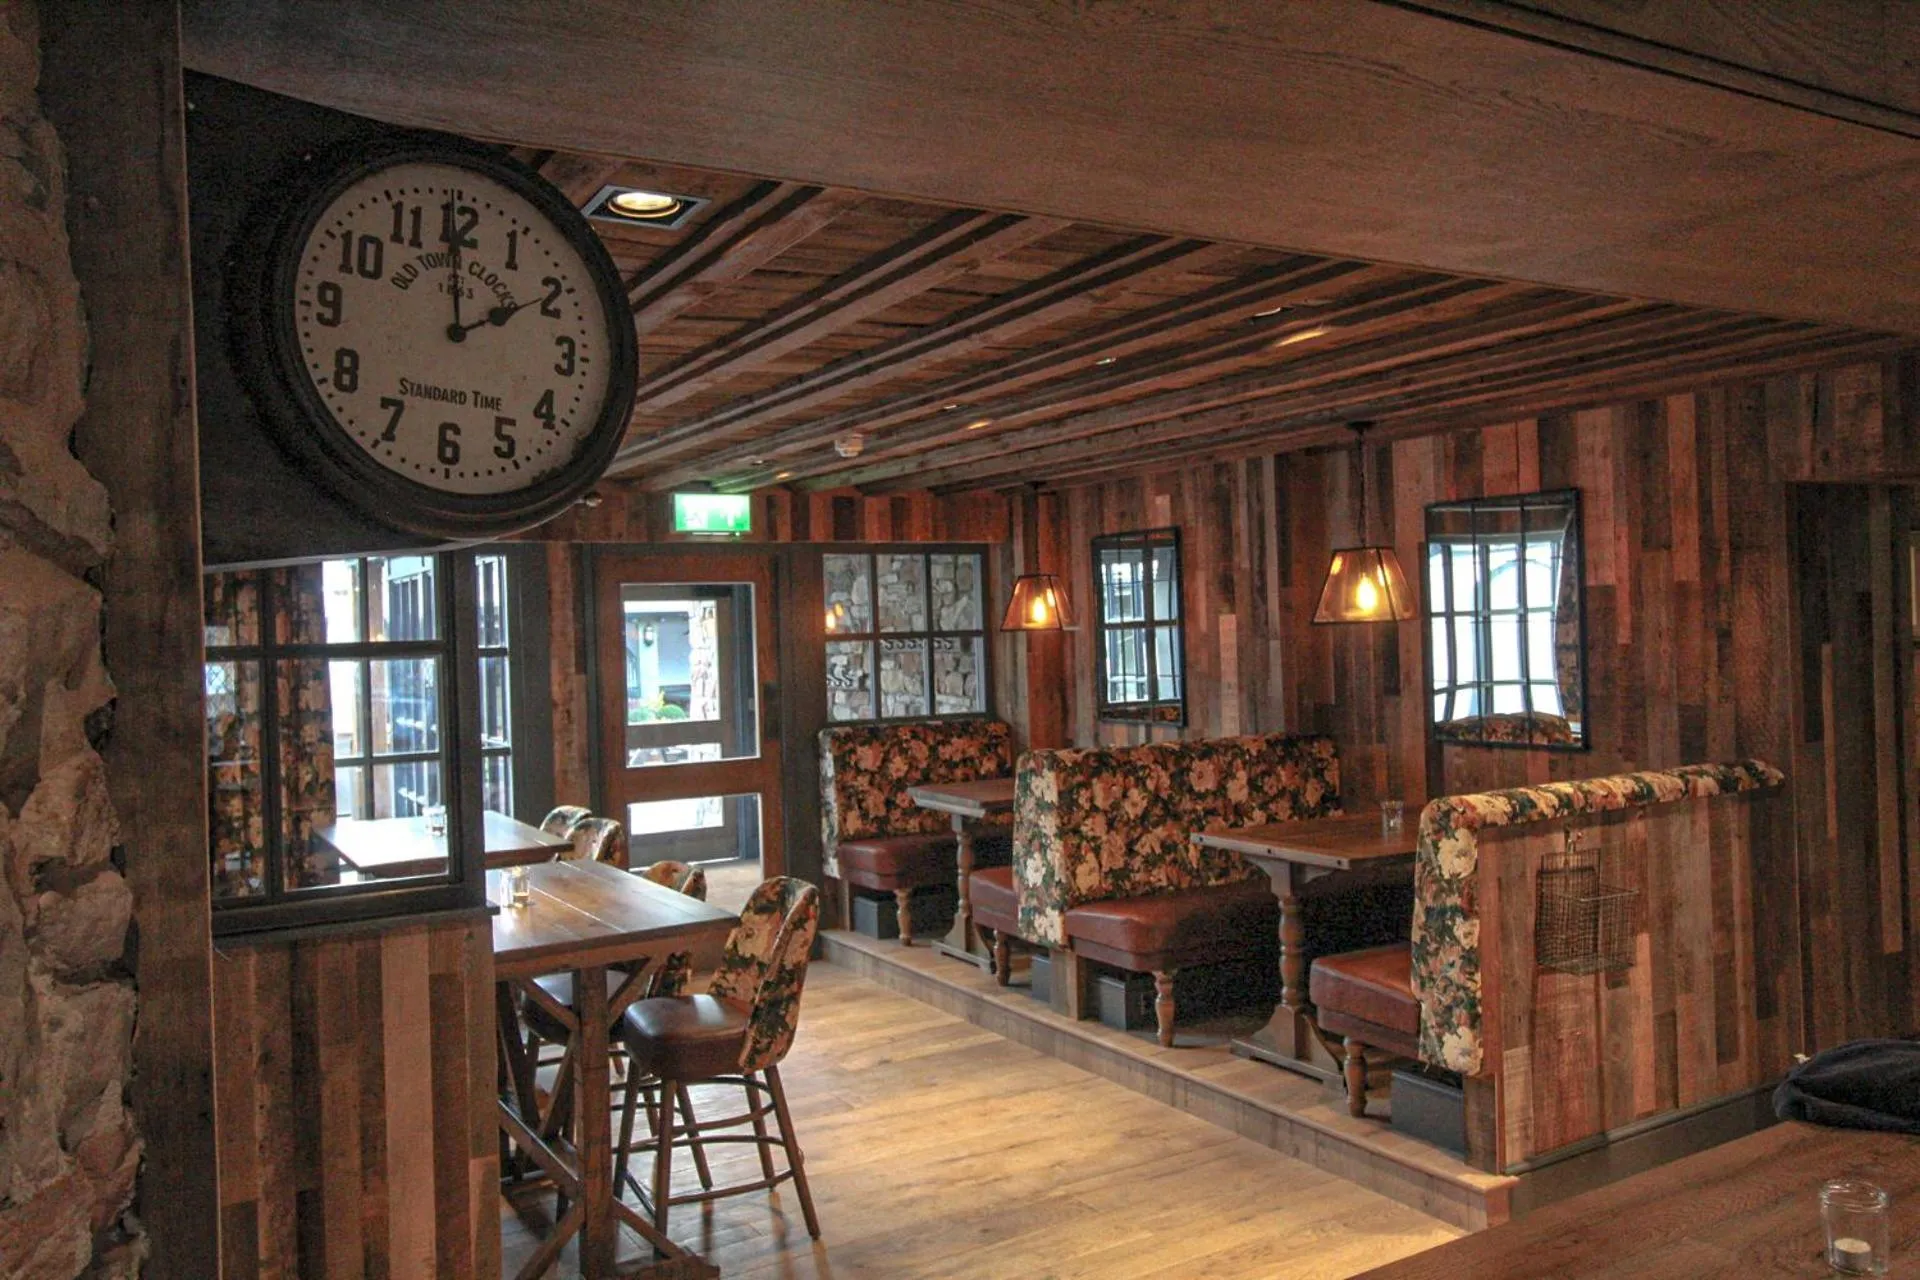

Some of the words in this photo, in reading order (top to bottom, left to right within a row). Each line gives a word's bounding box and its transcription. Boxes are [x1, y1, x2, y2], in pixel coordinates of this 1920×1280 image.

[390, 200, 423, 249] 11
[439, 202, 479, 249] 12
[338, 230, 384, 280] 10
[505, 229, 518, 271] 1
[391, 263, 419, 290] OLD
[540, 276, 562, 319] 2
[316, 281, 342, 327] 9
[333, 347, 359, 394] 8
[554, 336, 576, 377] 3
[399, 377, 467, 406] STANDARD
[472, 390, 502, 411] TIME
[533, 389, 556, 430] 4
[380, 396, 404, 442] 7
[494, 415, 517, 459] 5
[437, 422, 461, 466] 6
